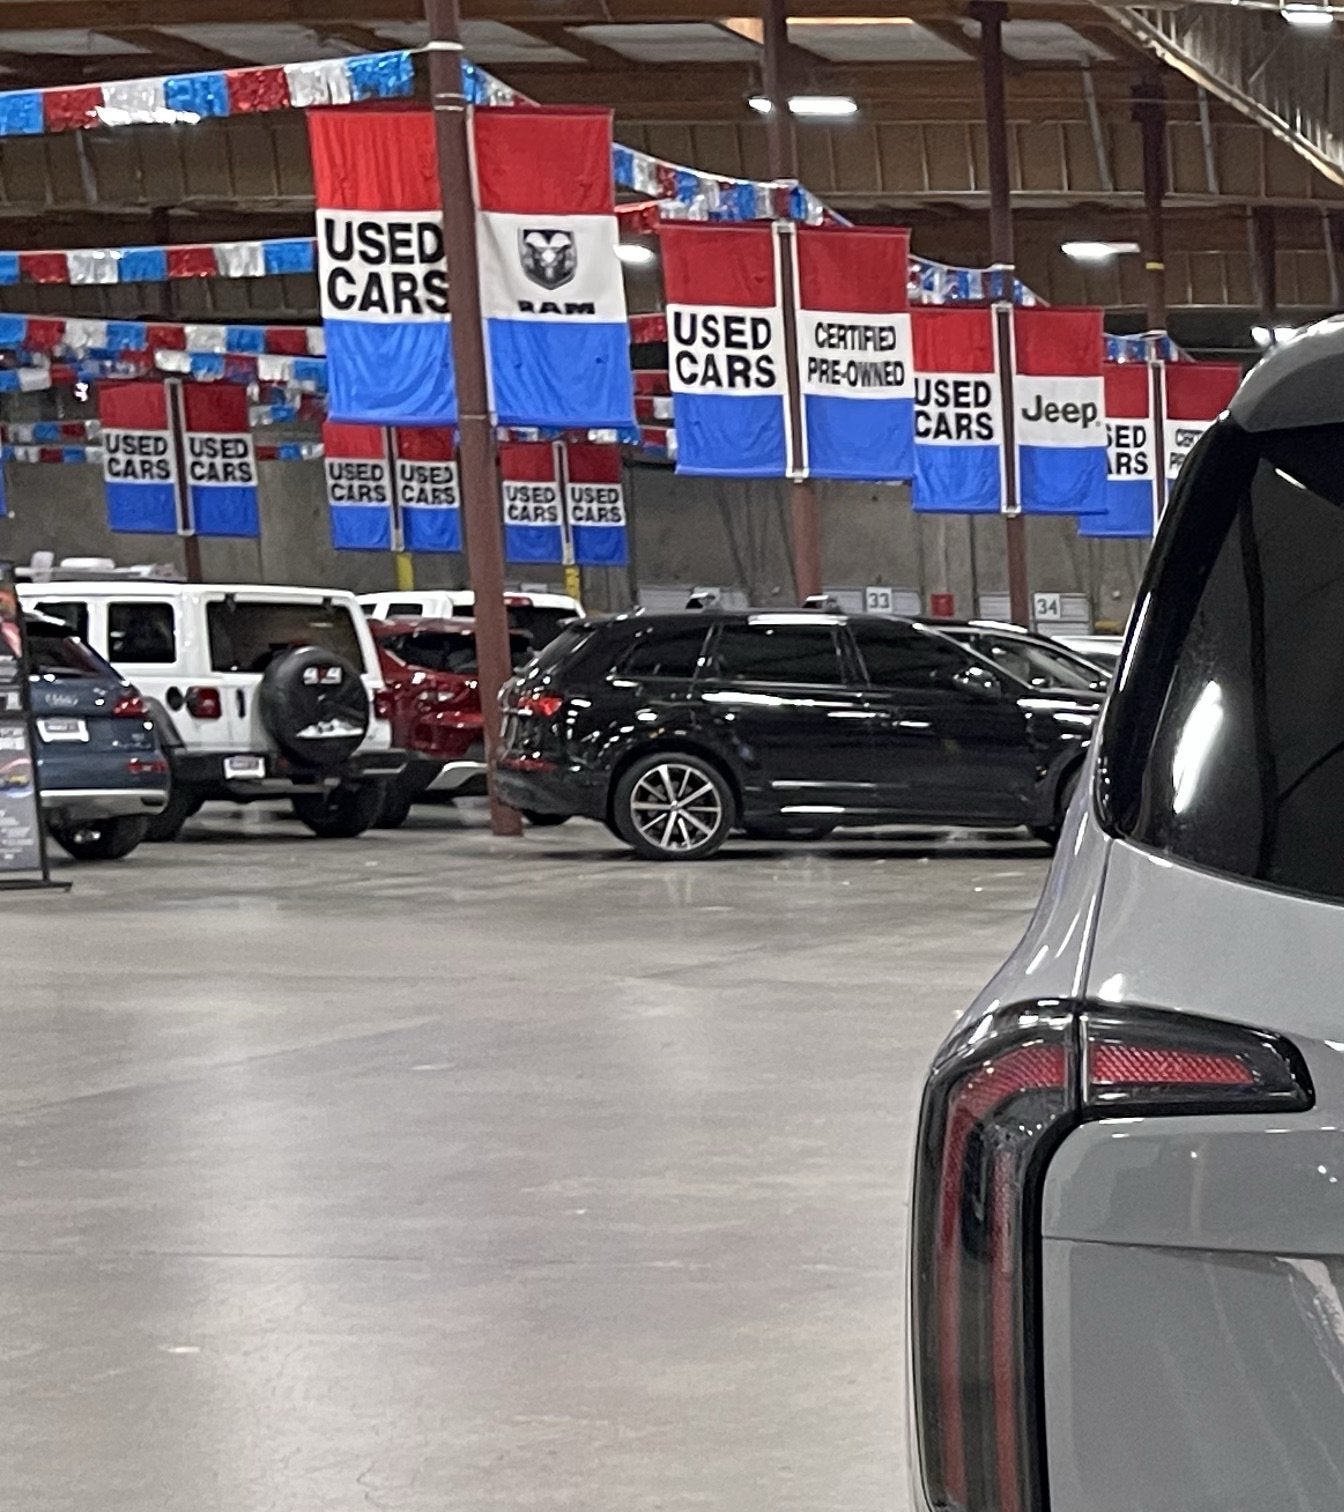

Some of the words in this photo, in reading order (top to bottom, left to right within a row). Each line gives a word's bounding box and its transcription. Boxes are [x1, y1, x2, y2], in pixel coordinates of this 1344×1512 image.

[324, 218, 446, 265] USED
[326, 266, 449, 314] CARS
[517, 300, 596, 315] RAM
[673, 311, 772, 350] USED
[814, 321, 897, 352] CERTIFIED
[675, 350, 777, 389] CARS
[806, 356, 906, 388] PRE-OWNED
[914, 377, 992, 409] USED
[1021, 394, 1098, 429] Jeep
[914, 409, 995, 441] CARS
[105, 433, 168, 457] USED
[189, 436, 249, 460] USED
[107, 457, 171, 480] CARS
[190, 461, 253, 483] CARS
[329, 462, 385, 482] USED
[401, 464, 454, 485] USED
[330, 482, 387, 503] CARS
[401, 484, 456, 505] CARS
[506, 485, 556, 504] USED
[570, 486, 620, 504] USED
[507, 504, 558, 522] CARS
[572, 505, 622, 523] CARS
[868, 592, 890, 609] 33
[1036, 598, 1058, 614] 34
